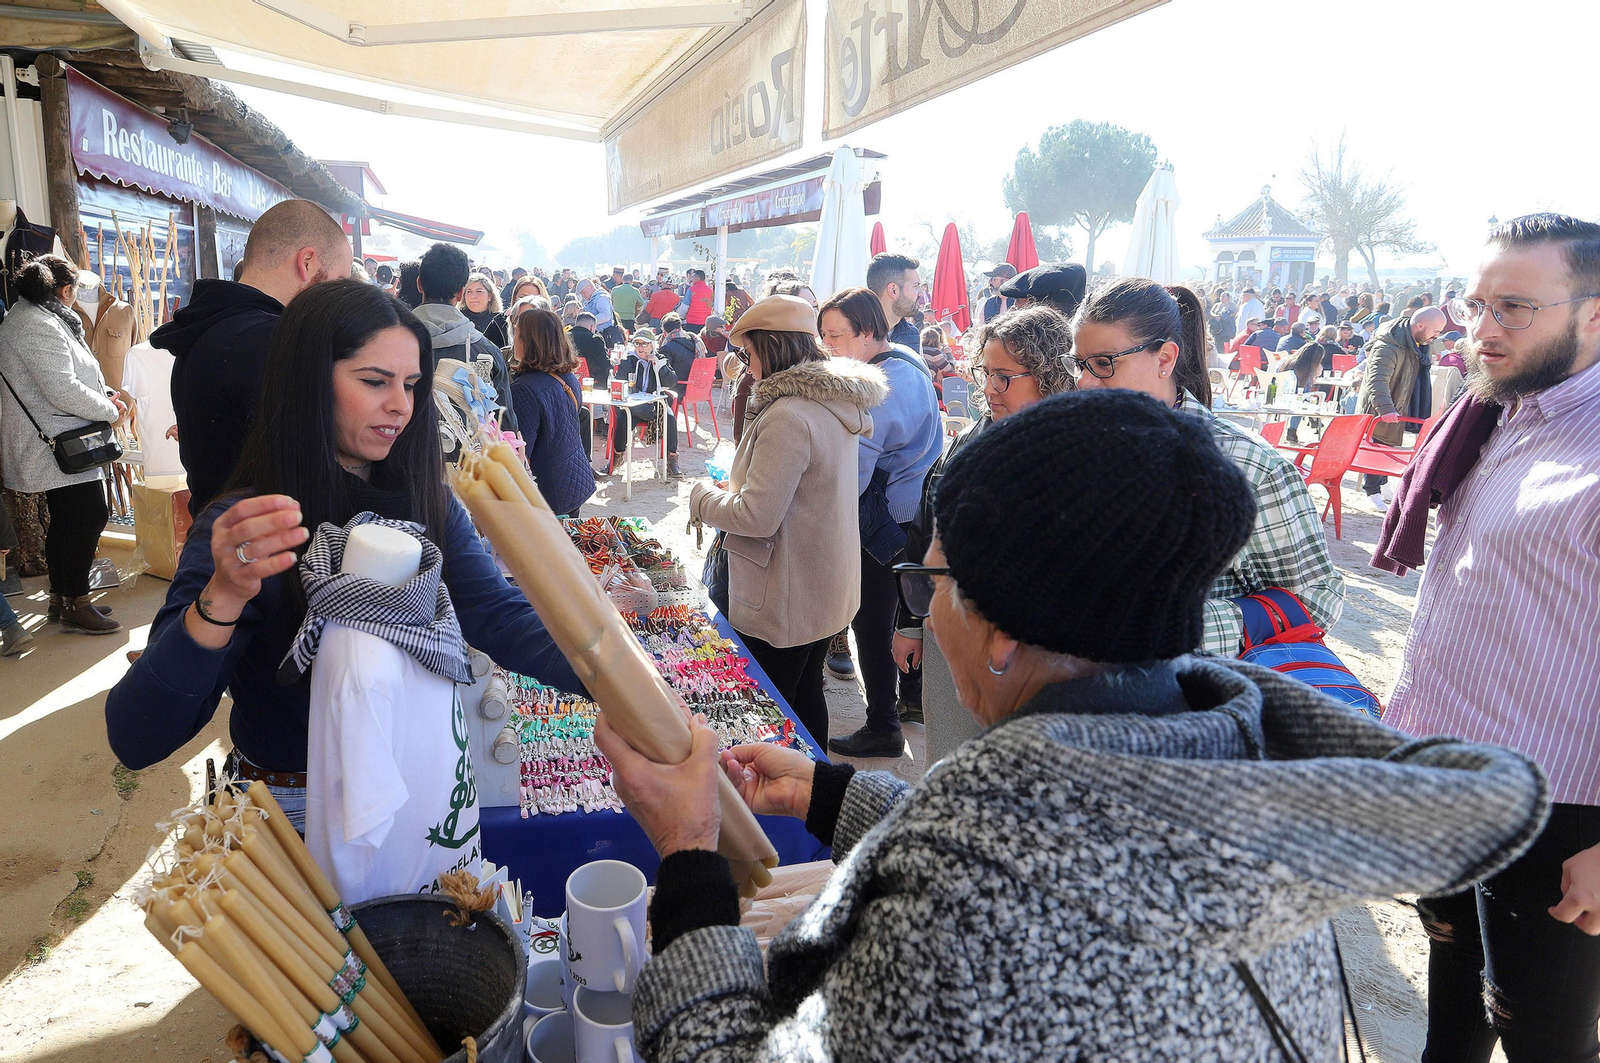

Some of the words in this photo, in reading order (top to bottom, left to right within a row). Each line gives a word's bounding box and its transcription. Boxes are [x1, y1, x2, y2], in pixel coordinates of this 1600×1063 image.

[101, 107, 205, 188] Restaurante
[212, 160, 233, 198] Bar
[774, 192, 806, 210] Cruzcampo
[573, 971, 587, 986] 2023
